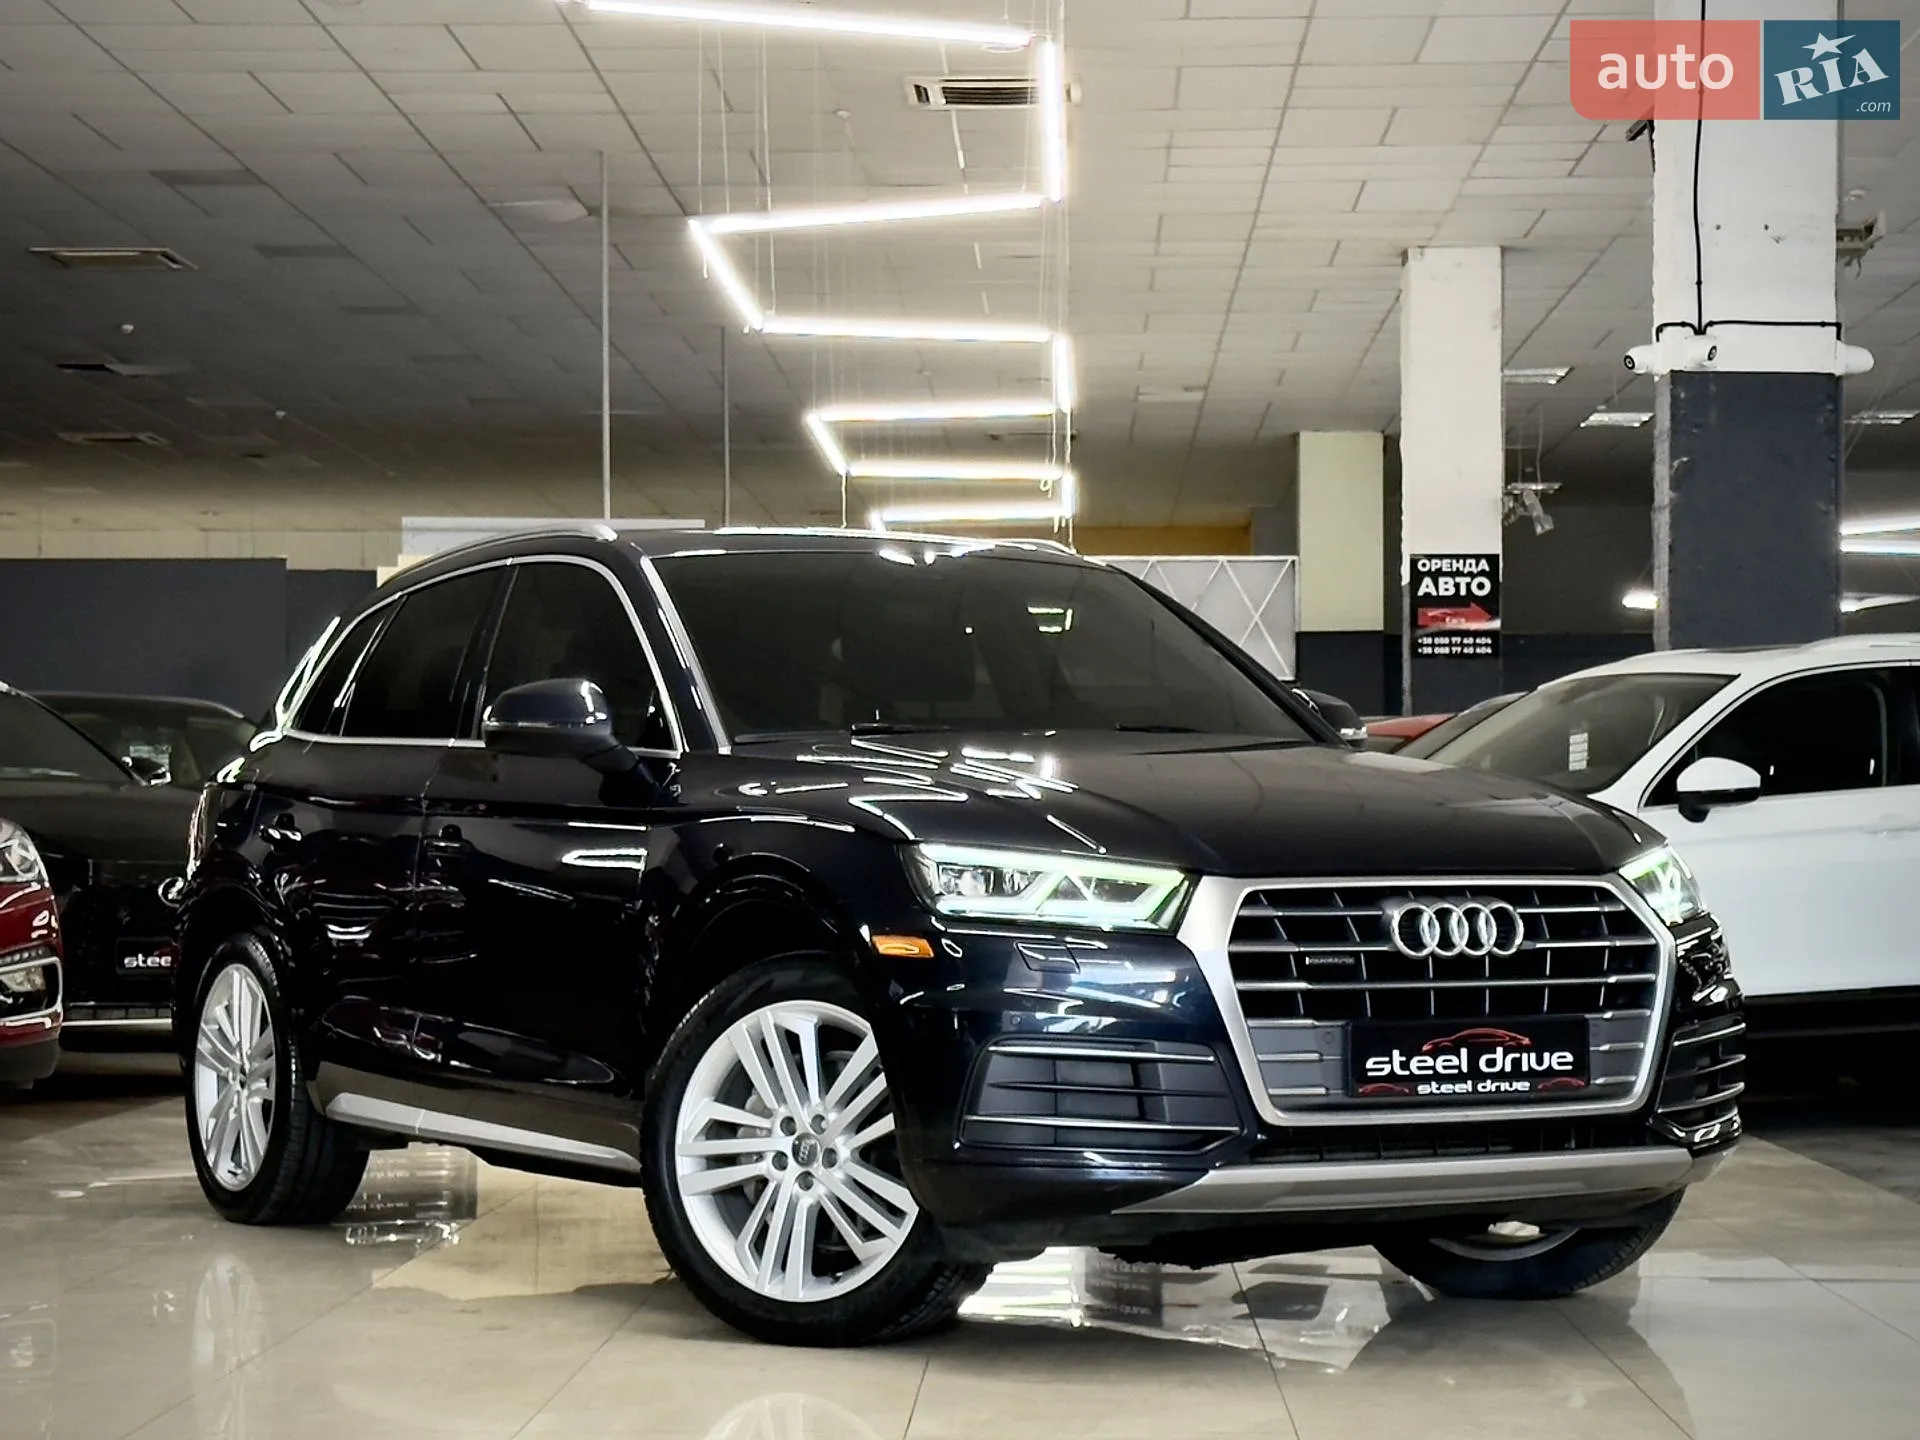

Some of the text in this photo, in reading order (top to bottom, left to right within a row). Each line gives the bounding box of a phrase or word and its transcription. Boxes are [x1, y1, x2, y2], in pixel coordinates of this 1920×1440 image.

[1417, 558, 1490, 574] ОРЕНДА
[1417, 576, 1492, 597] АВТО
[1366, 1046, 1574, 1077] steel drive
[1417, 1079, 1531, 1095] steel drive
